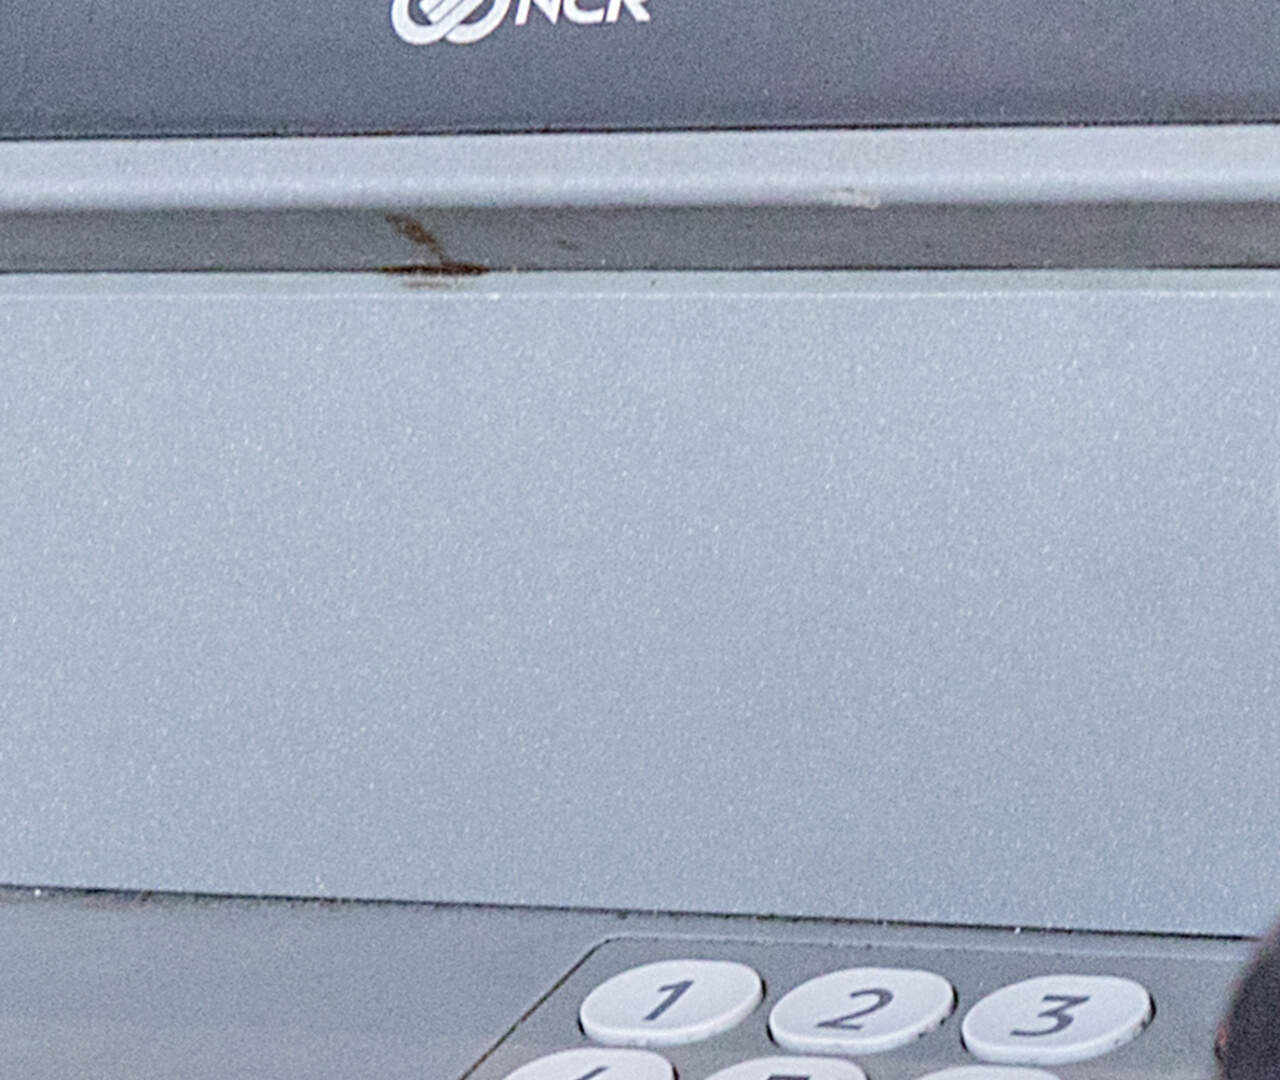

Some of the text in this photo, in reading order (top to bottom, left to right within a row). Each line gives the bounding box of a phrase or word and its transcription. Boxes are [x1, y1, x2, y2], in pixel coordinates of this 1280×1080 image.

[515, 0, 651, 26] NCR
[645, 979, 1090, 1037] 1 2 3
